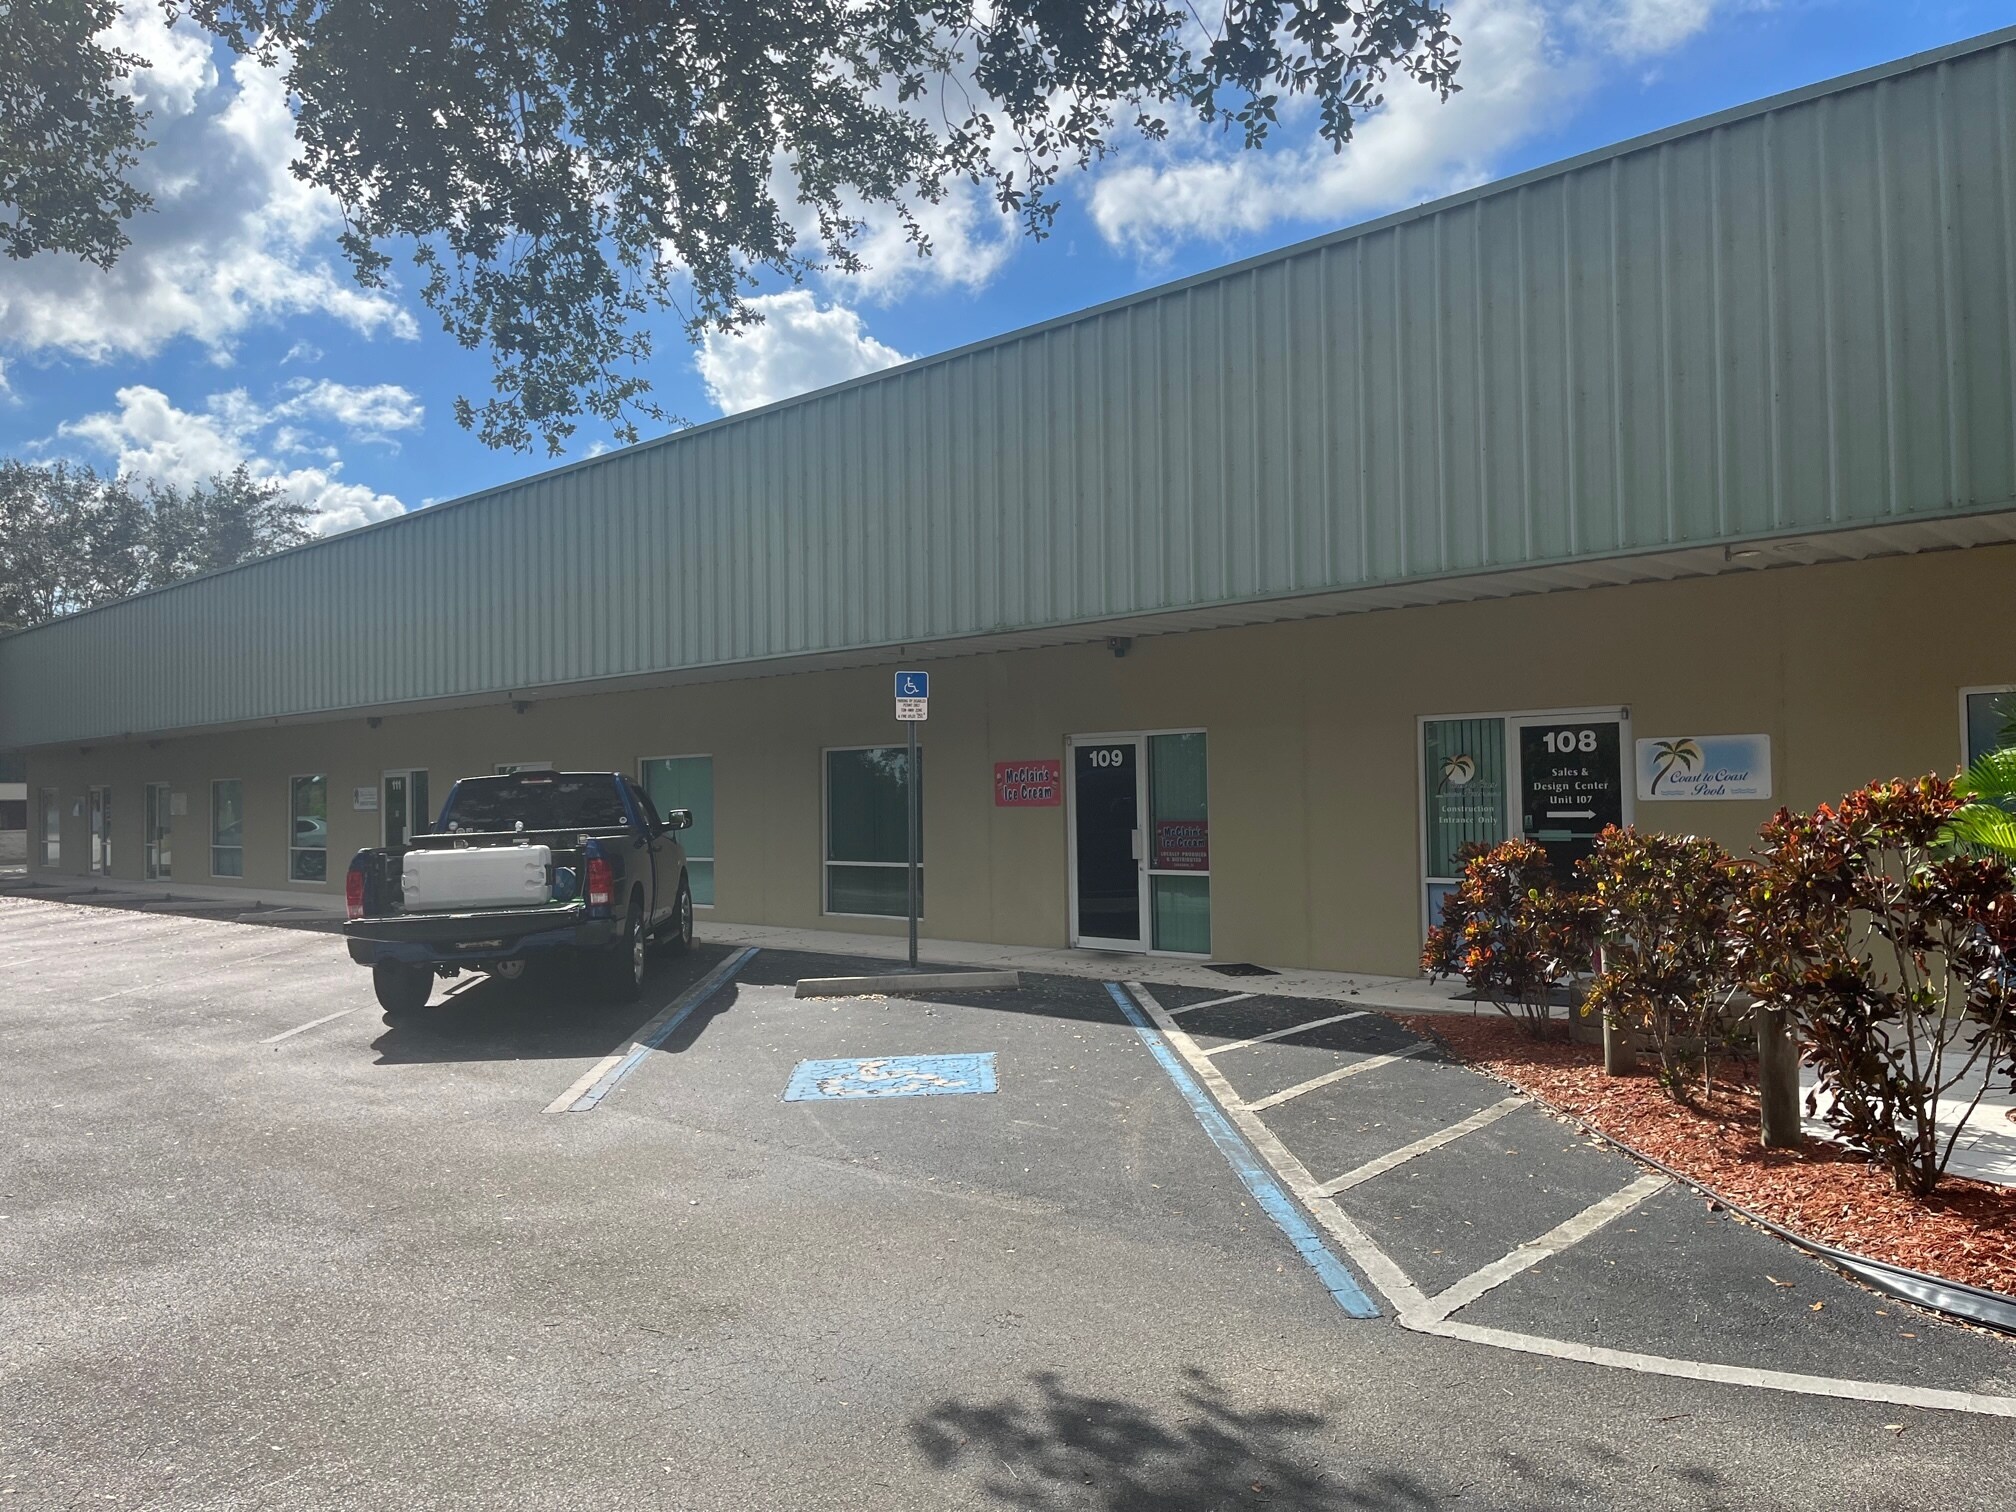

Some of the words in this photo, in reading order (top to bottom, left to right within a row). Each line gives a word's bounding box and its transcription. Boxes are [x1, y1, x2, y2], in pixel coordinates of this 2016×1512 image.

[1542, 730, 1597, 753] 108
[1089, 749, 1123, 767] 109
[1005, 765, 1049, 784] McClain's
[1551, 767, 1578, 777] Sales
[1581, 767, 1589, 776] &
[1670, 770, 1701, 783] Coast
[1702, 772, 1714, 782] to
[1715, 768, 1749, 782] Coast
[392, 780, 401, 790] 111
[1533, 781, 1569, 793] Design
[1574, 781, 1609, 790] Center
[1690, 783, 1726, 796] Pools
[1003, 784, 1018, 801] Ice
[1021, 783, 1052, 800] Cream
[1549, 795, 1573, 804] Unit
[1576, 795, 1593, 804] 107
[1441, 805, 1494, 813] Construction
[1438, 816, 1474, 824] Entrance
[1477, 815, 1498, 826] Only
[1162, 825, 1202, 837] McClain's
[1161, 836, 1176, 849] Ice
[1176, 836, 1206, 848] Cream
